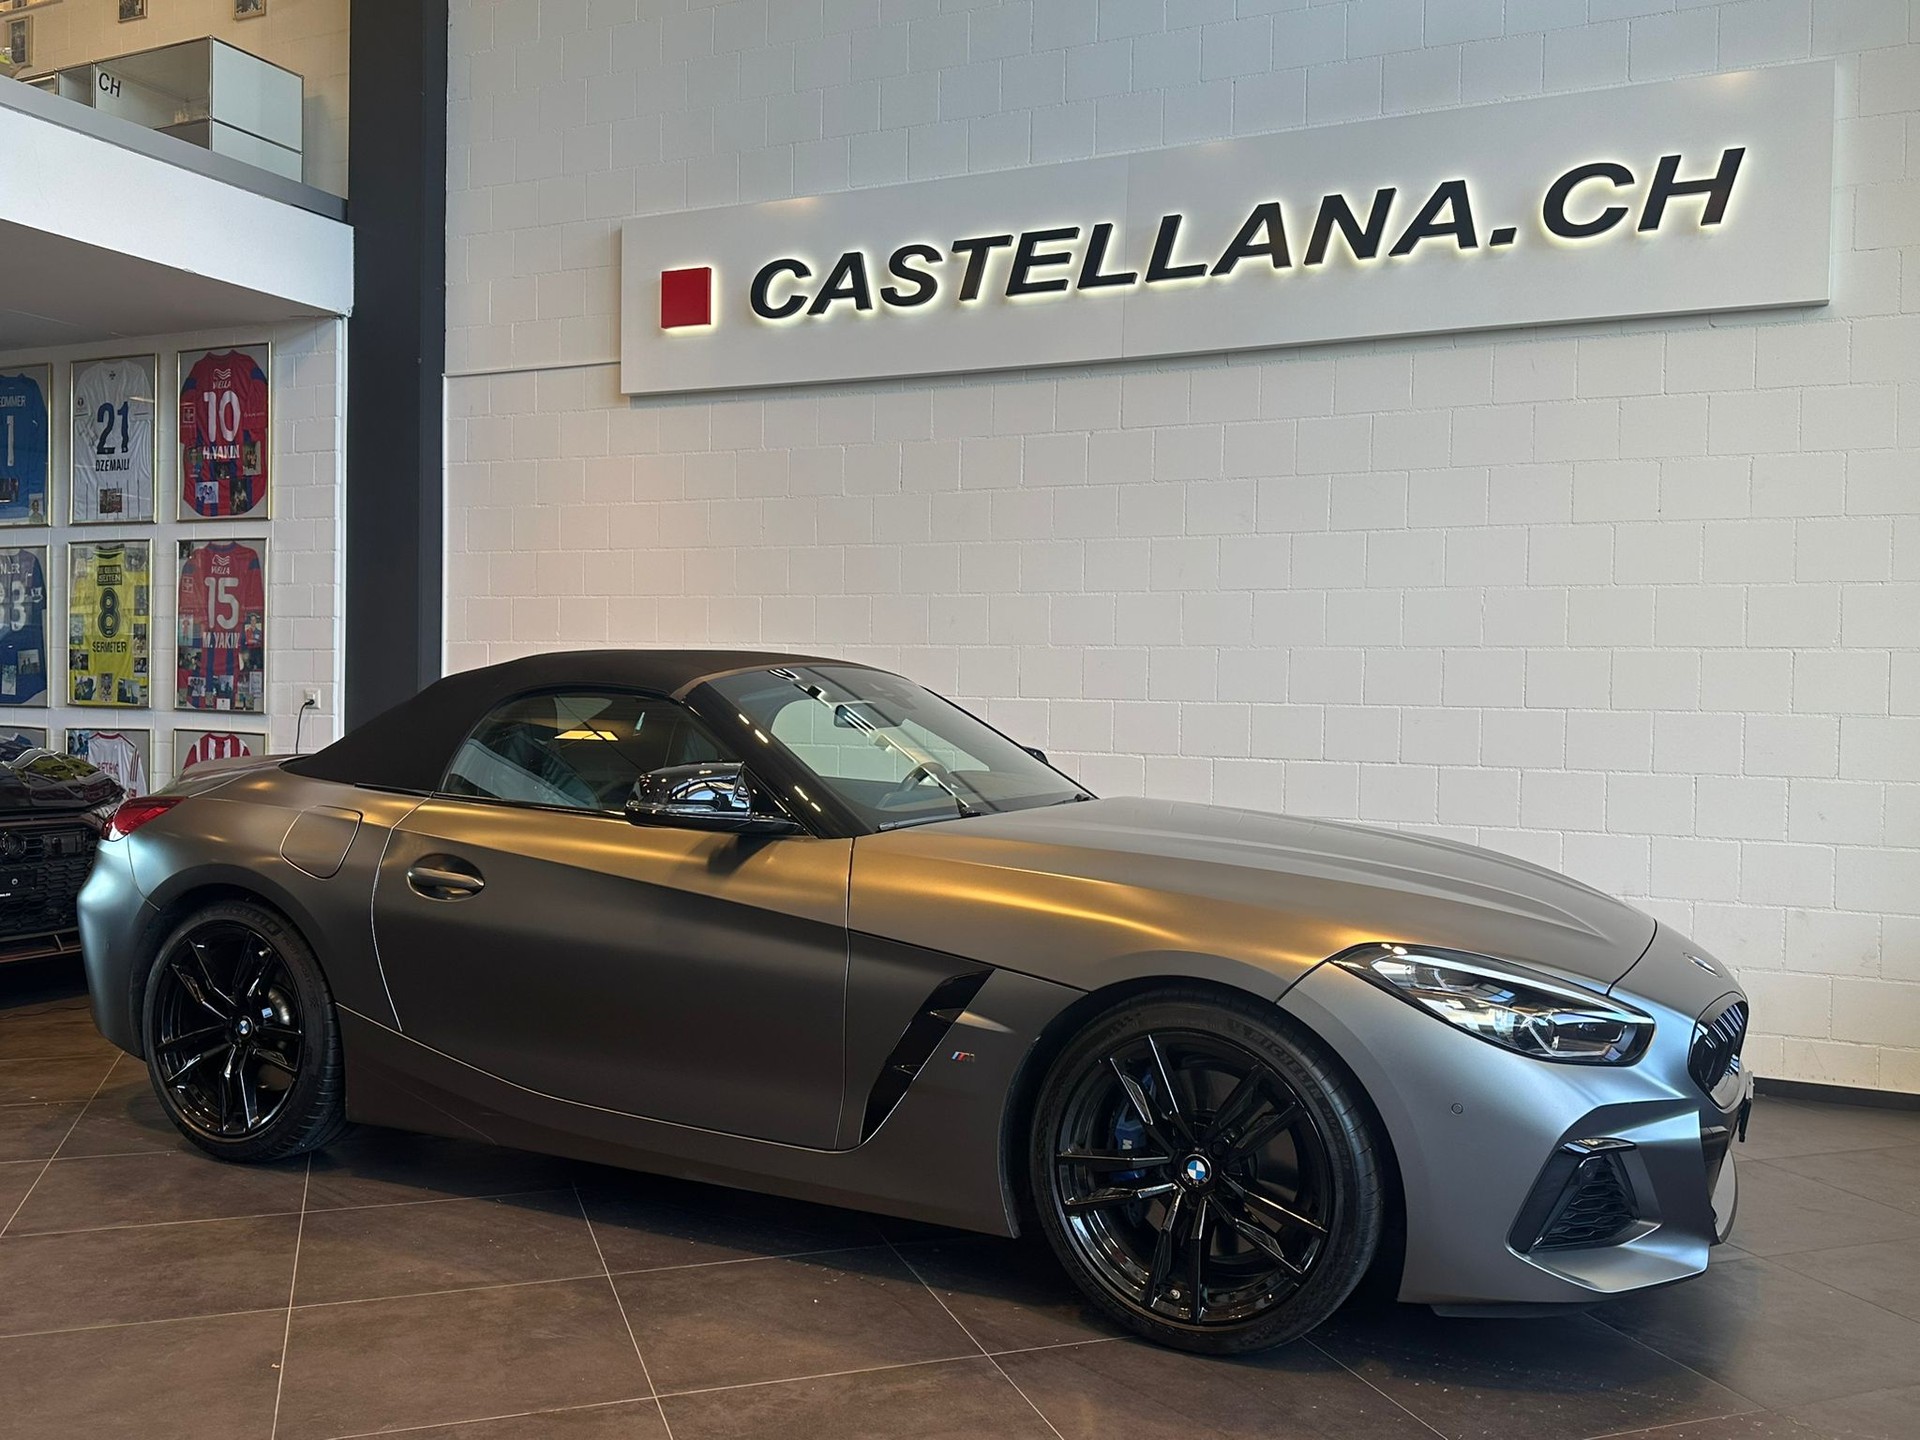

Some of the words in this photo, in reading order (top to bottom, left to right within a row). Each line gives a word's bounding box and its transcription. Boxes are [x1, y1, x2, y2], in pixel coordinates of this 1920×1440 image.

[99, 72, 121, 98] CH
[750, 147, 1746, 319] CASTELLANA.CH
[0, 395, 26, 407] OMMER
[203, 390, 241, 442] 10
[7, 415, 14, 467] 1
[97, 401, 129, 455] 21
[98, 587, 121, 638] 8
[204, 577, 239, 629] 15
